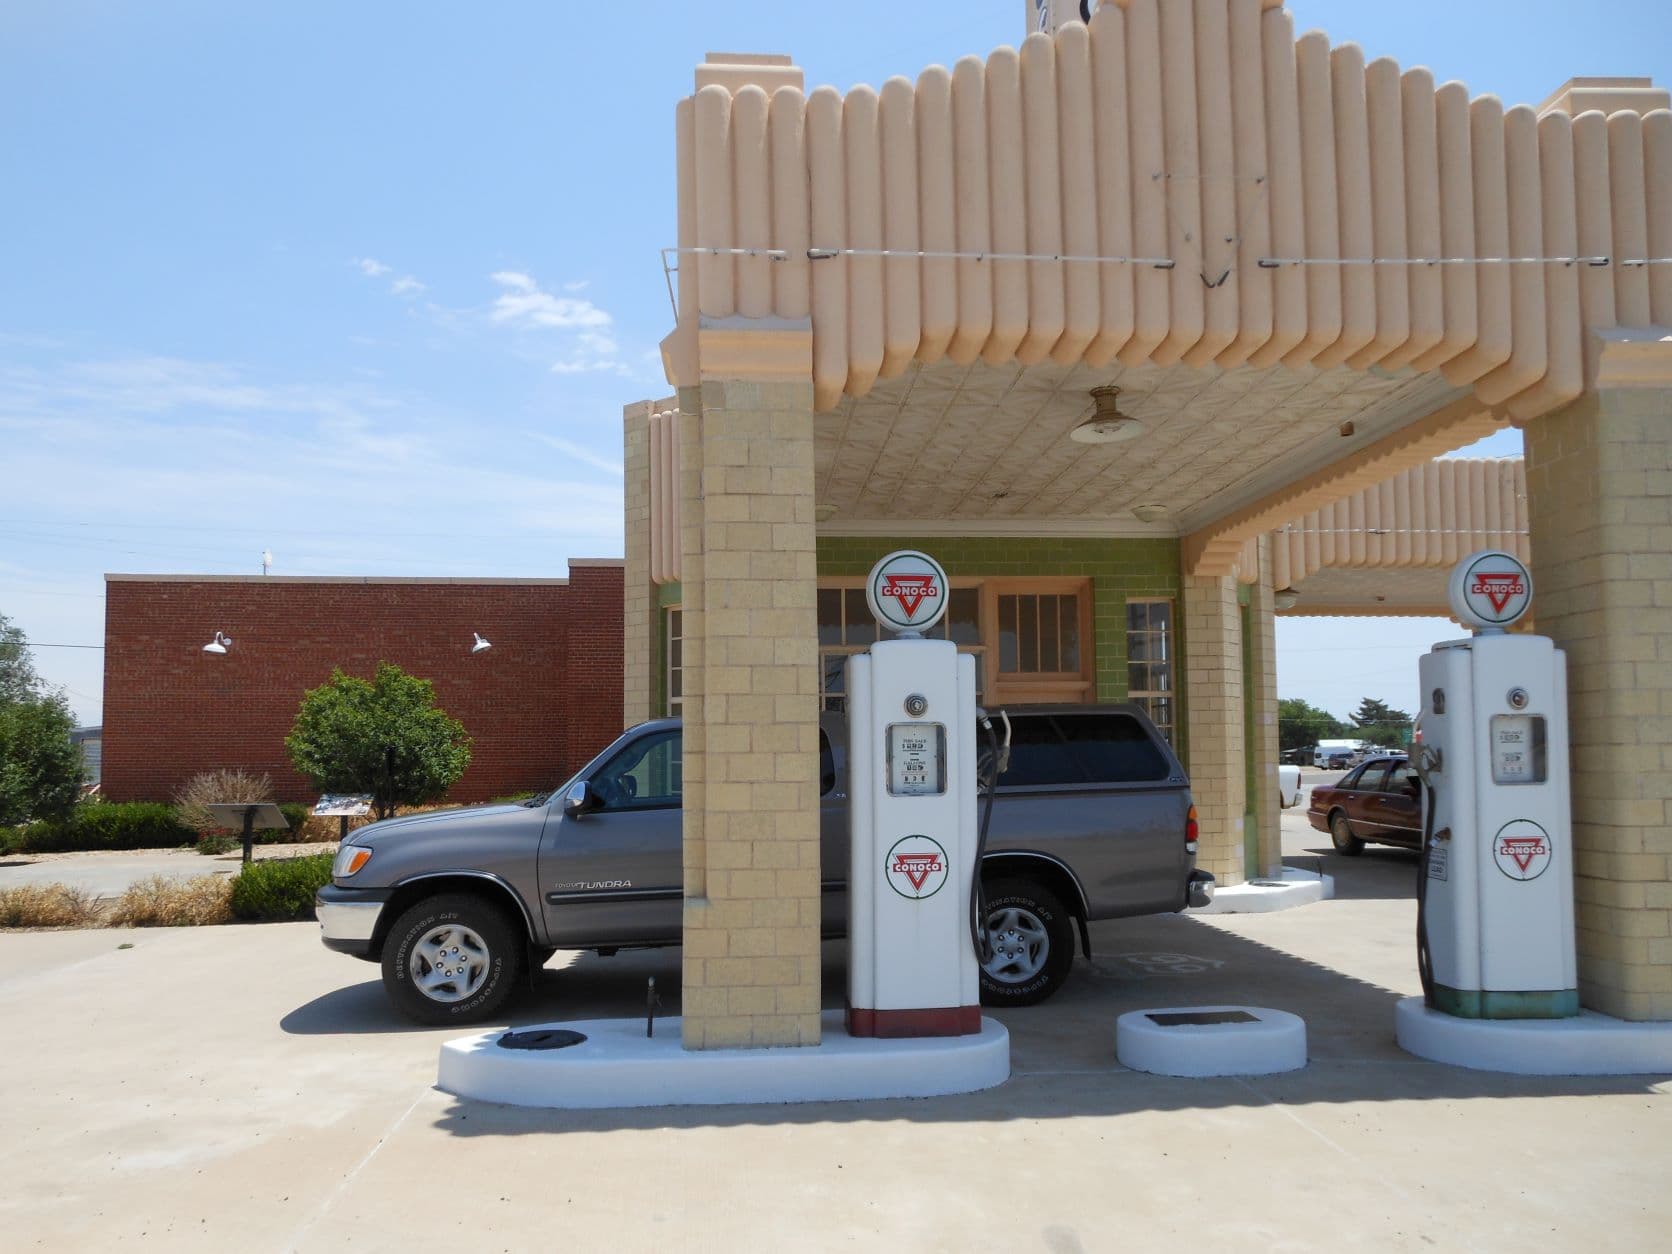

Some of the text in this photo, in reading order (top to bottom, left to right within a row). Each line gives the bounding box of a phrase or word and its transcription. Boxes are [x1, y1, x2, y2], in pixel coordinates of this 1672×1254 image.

[883, 587, 936, 595] CONOCO
[1473, 585, 1523, 593] CONOCO
[895, 863, 940, 871] CONOCO
[577, 880, 632, 889] TUNDRA
